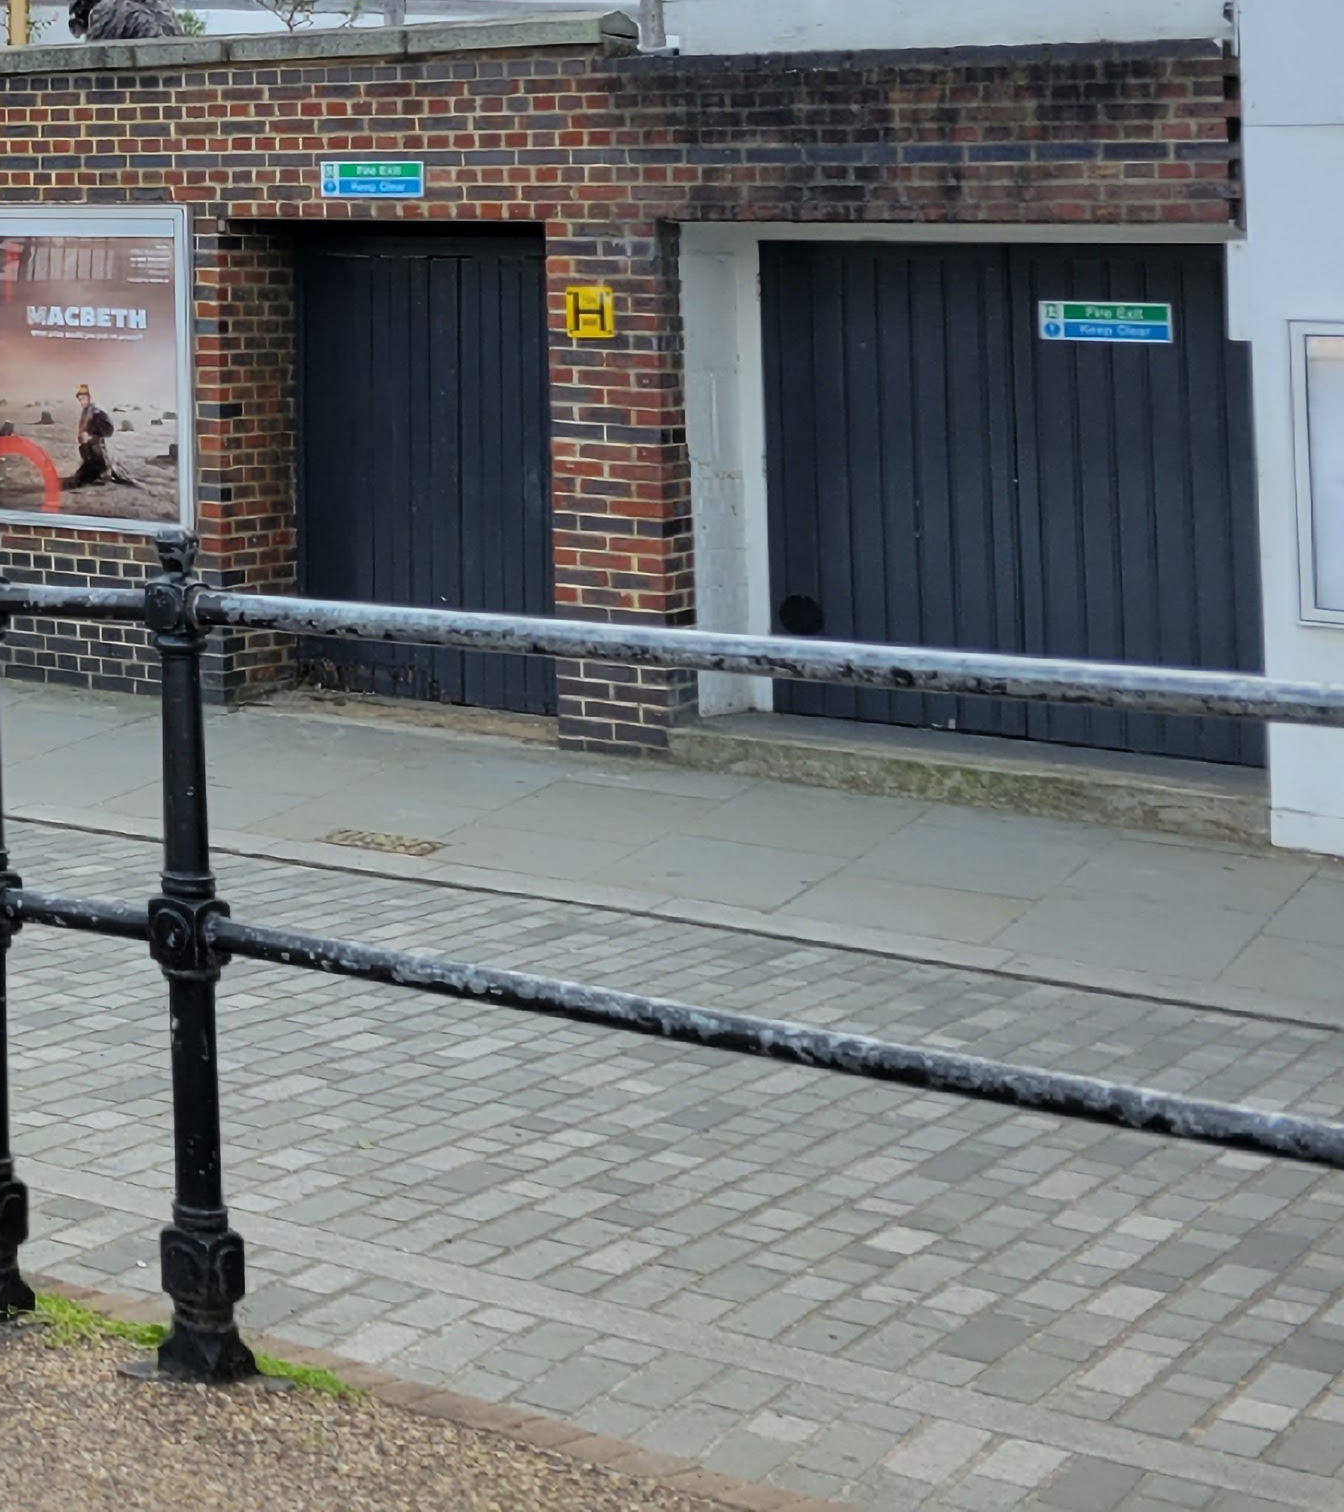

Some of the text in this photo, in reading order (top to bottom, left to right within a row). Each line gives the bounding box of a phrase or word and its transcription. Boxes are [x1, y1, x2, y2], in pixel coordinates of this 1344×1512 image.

[356, 166, 402, 176] Fire Exit
[27, 305, 147, 329] MACBETH
[572, 292, 606, 332] H
[1085, 306, 1144, 320] Fire Exit
[1079, 325, 1151, 336] Keep Clear
